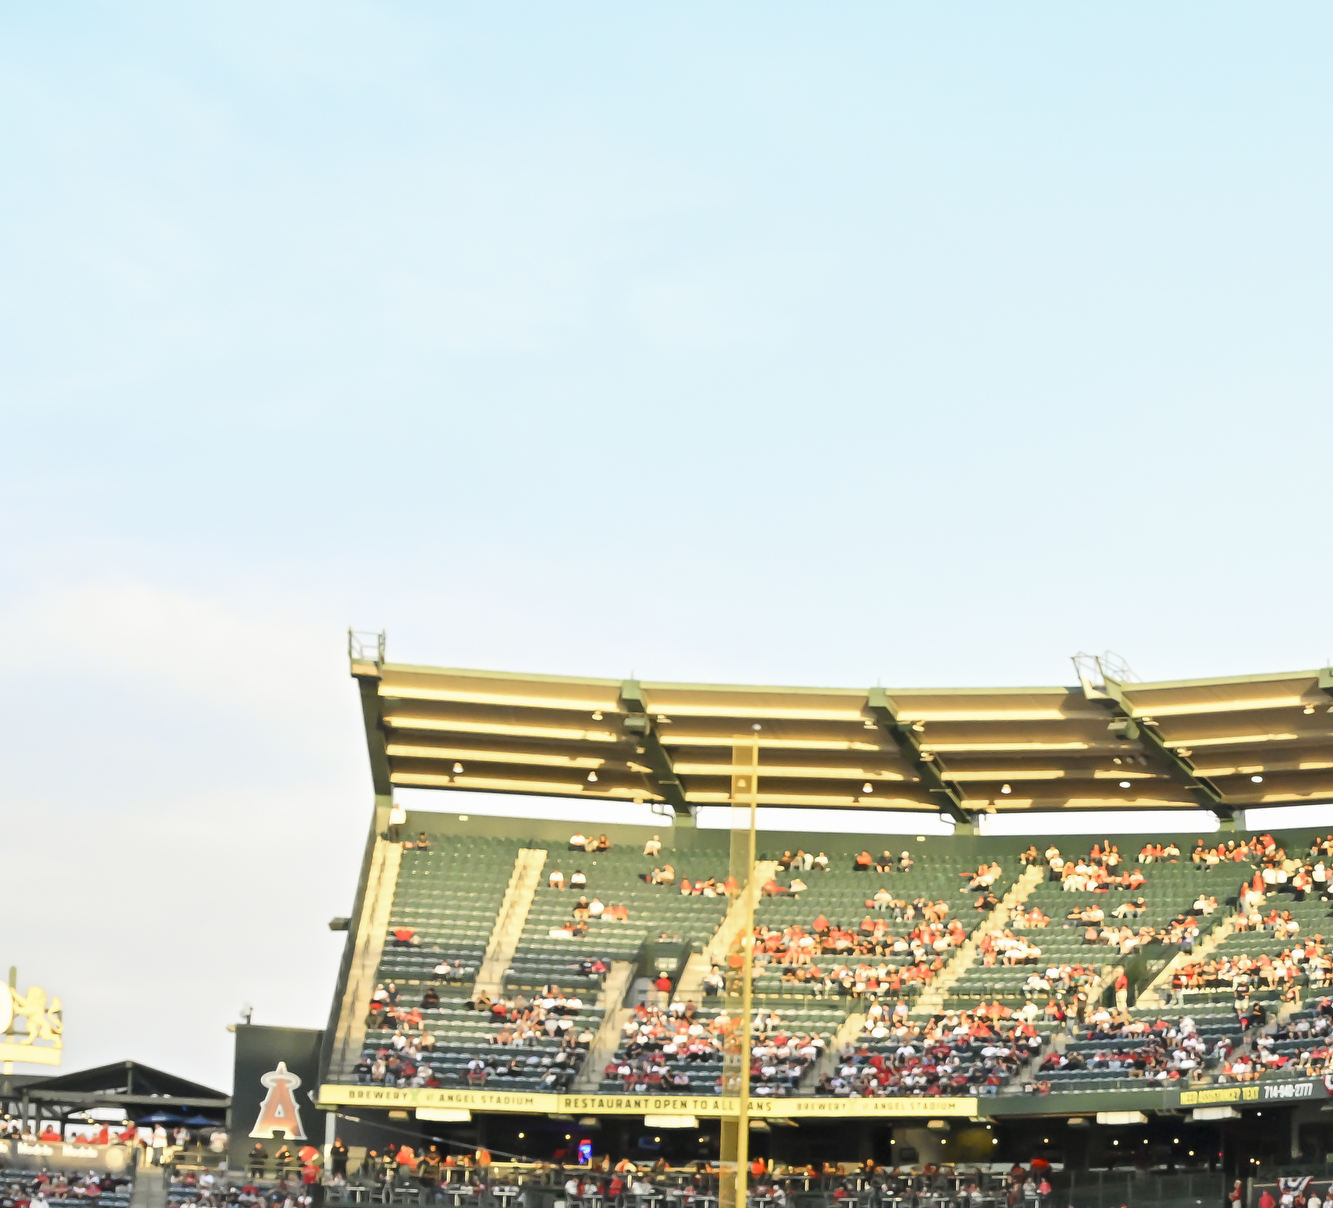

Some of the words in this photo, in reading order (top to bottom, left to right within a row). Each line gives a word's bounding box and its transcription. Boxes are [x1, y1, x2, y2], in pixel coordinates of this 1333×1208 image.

[349, 1090, 408, 1100] BREWERY
[439, 1094, 476, 1104] ANGEL
[481, 1095, 534, 1105] STADIUM
[564, 1098, 649, 1109] RESTAURANT
[654, 1100, 688, 1110] OPEN
[693, 1101, 708, 1110] TO
[747, 1102, 772, 1112] ANS
[797, 1103, 846, 1111] BREWERY
